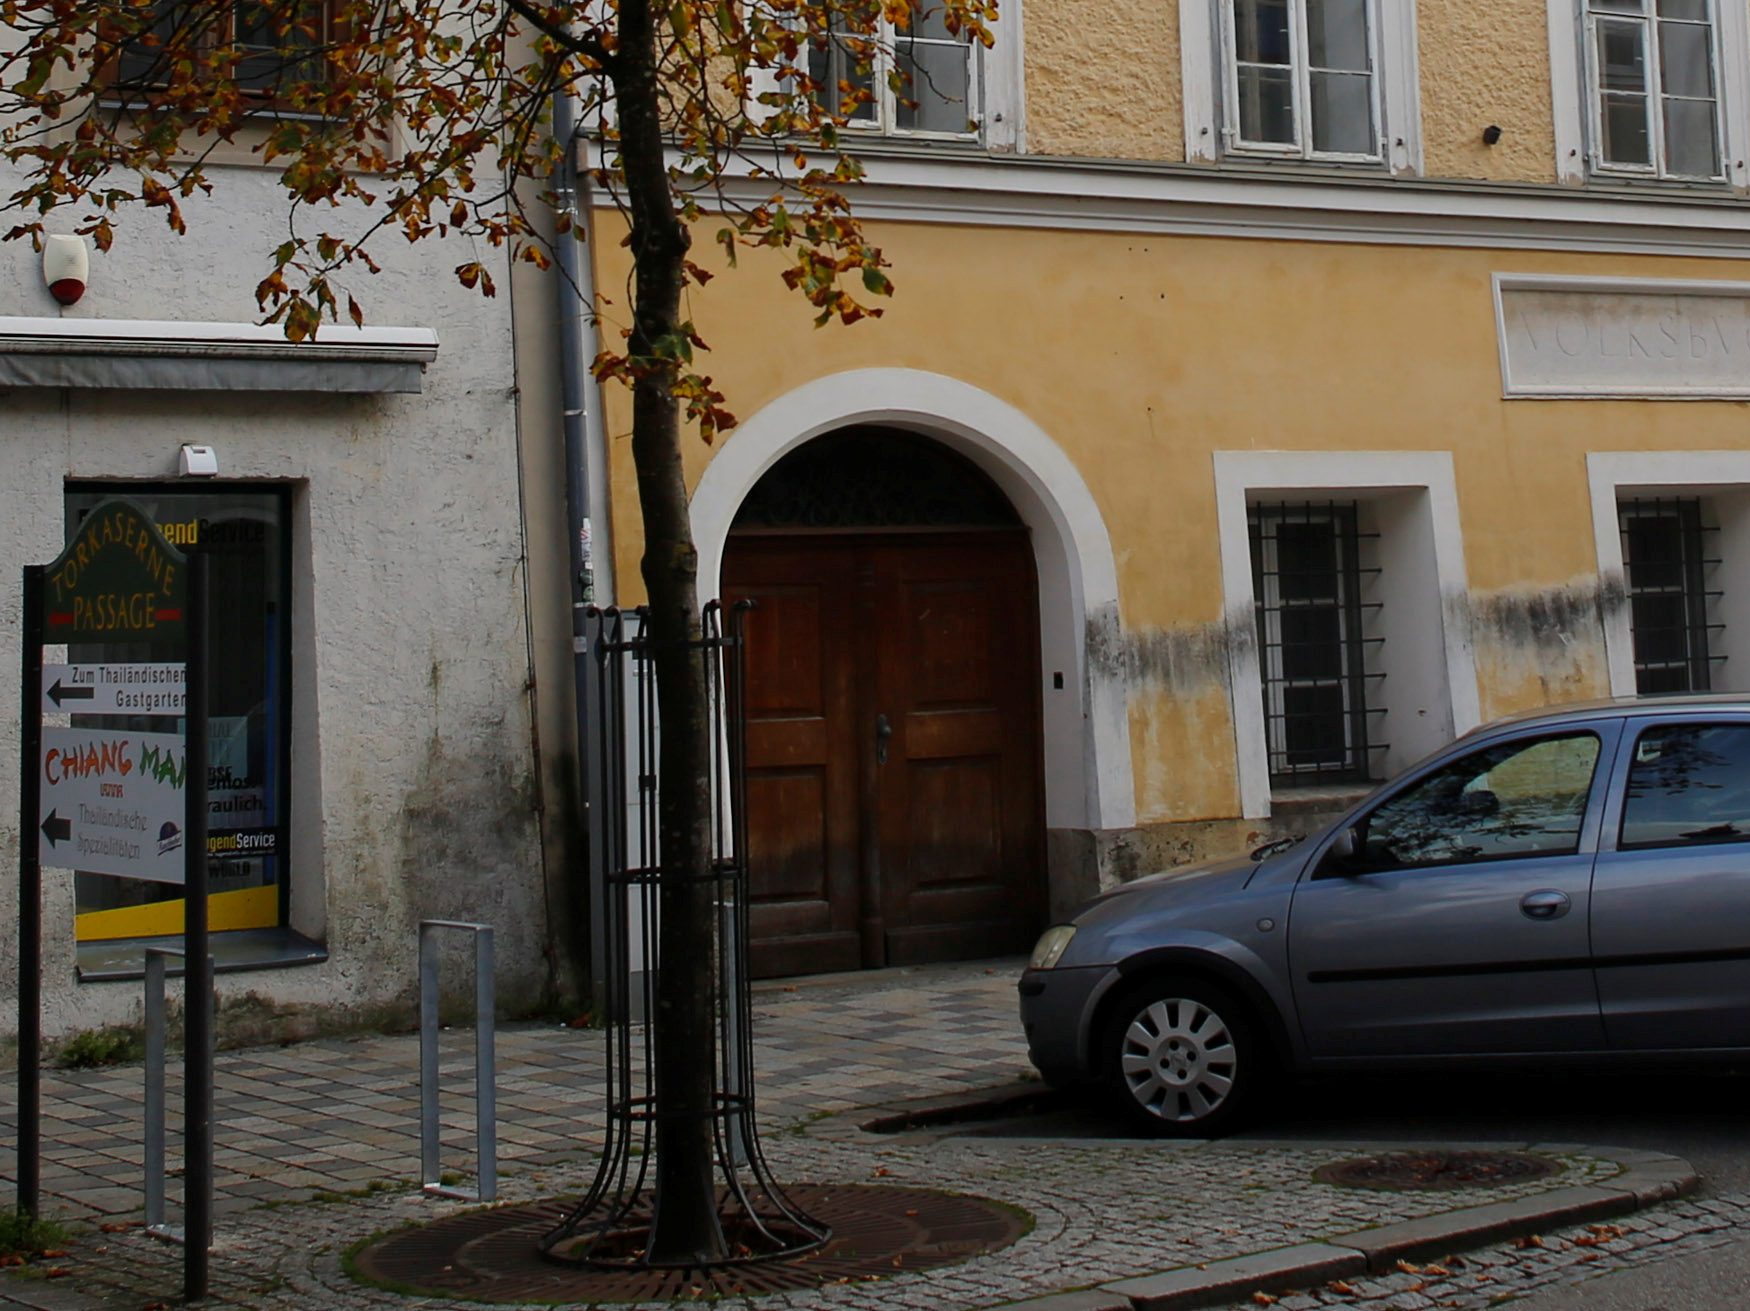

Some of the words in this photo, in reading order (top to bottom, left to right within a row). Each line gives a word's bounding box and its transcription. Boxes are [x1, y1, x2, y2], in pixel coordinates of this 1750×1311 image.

[52, 511, 175, 602] TORKASERNE
[72, 592, 156, 631] PASSAGE
[72, 667, 95, 684] Zum
[100, 666, 187, 685] Thailändischen
[45, 740, 133, 785] CHIANG
[208, 795, 268, 813] raulich.
